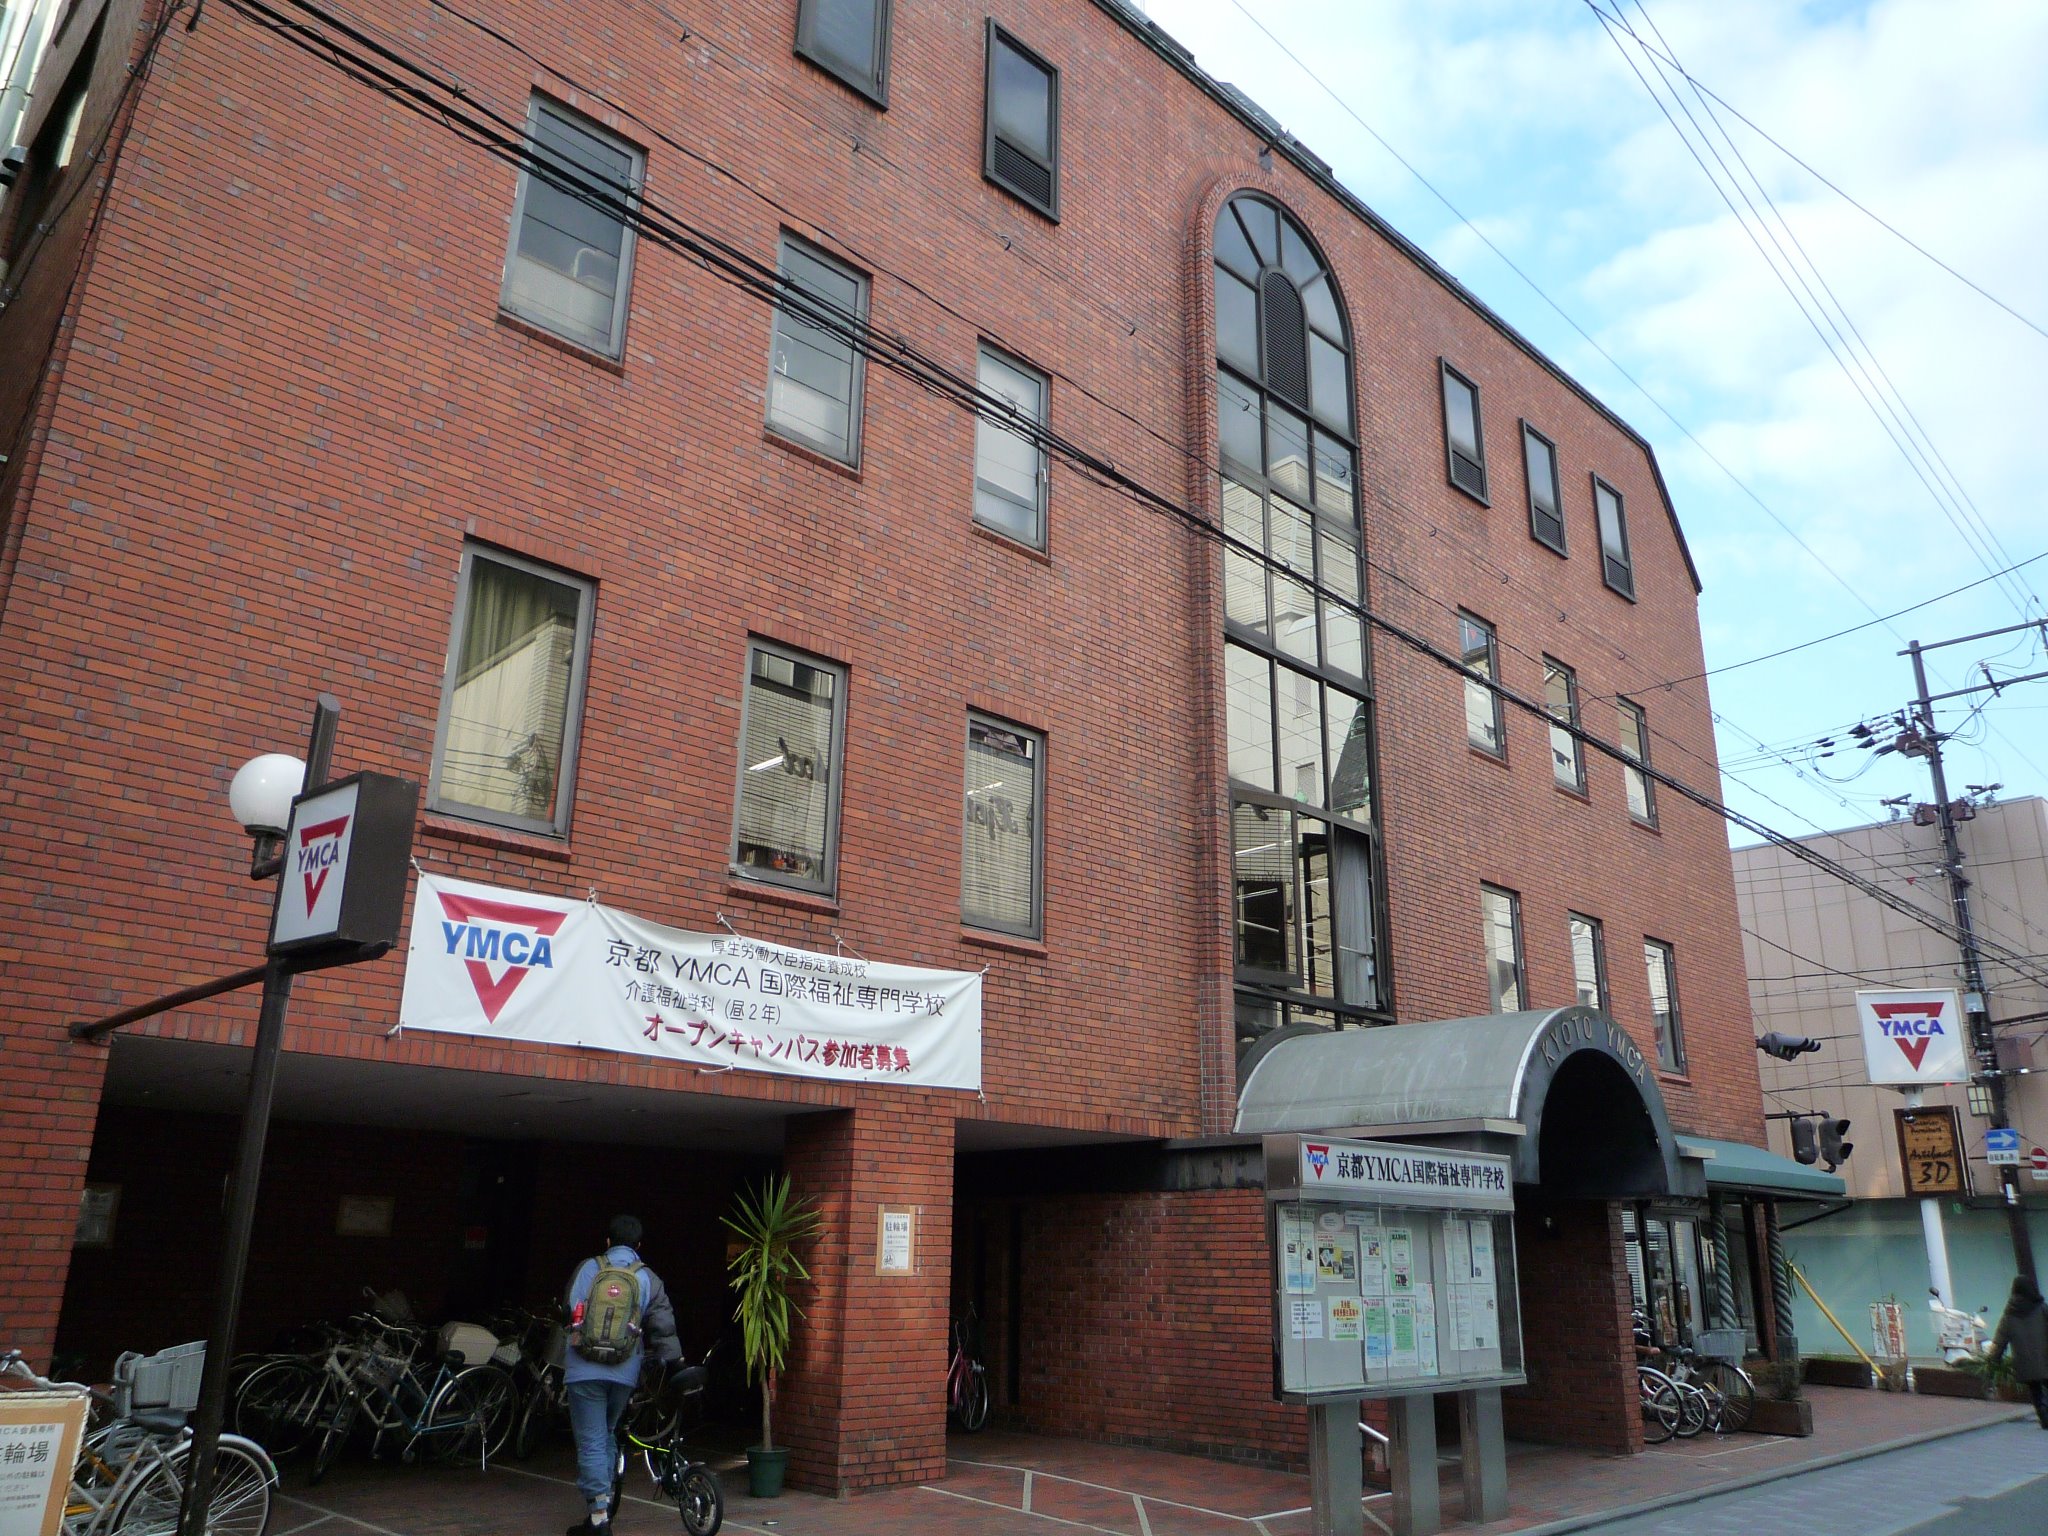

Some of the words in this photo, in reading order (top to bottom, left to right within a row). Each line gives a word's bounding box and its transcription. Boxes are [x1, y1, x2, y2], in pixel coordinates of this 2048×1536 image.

[298, 840, 339, 873] YMCA
[442, 921, 554, 969] YMCA
[711, 939, 867, 979] 厚生労働大臣指定養成校
[606, 938, 661, 974] 京都
[671, 954, 751, 989] YMCA
[759, 967, 946, 1017] 国際福祉専門学校
[625, 979, 716, 1016] 介護福祉学科
[642, 1012, 911, 1073] オープンキャンパス参加者募集
[1877, 1019, 1945, 1037] YMCA
[1540, 1015, 1594, 1068] KYOTO
[1605, 1023, 1648, 1085] YMCA
[1306, 1152, 1330, 1166] YMCA
[1336, 1152, 1505, 1191] 京都YMCA国際福祉専門学校
[1917, 1160, 1951, 1184] 3D
